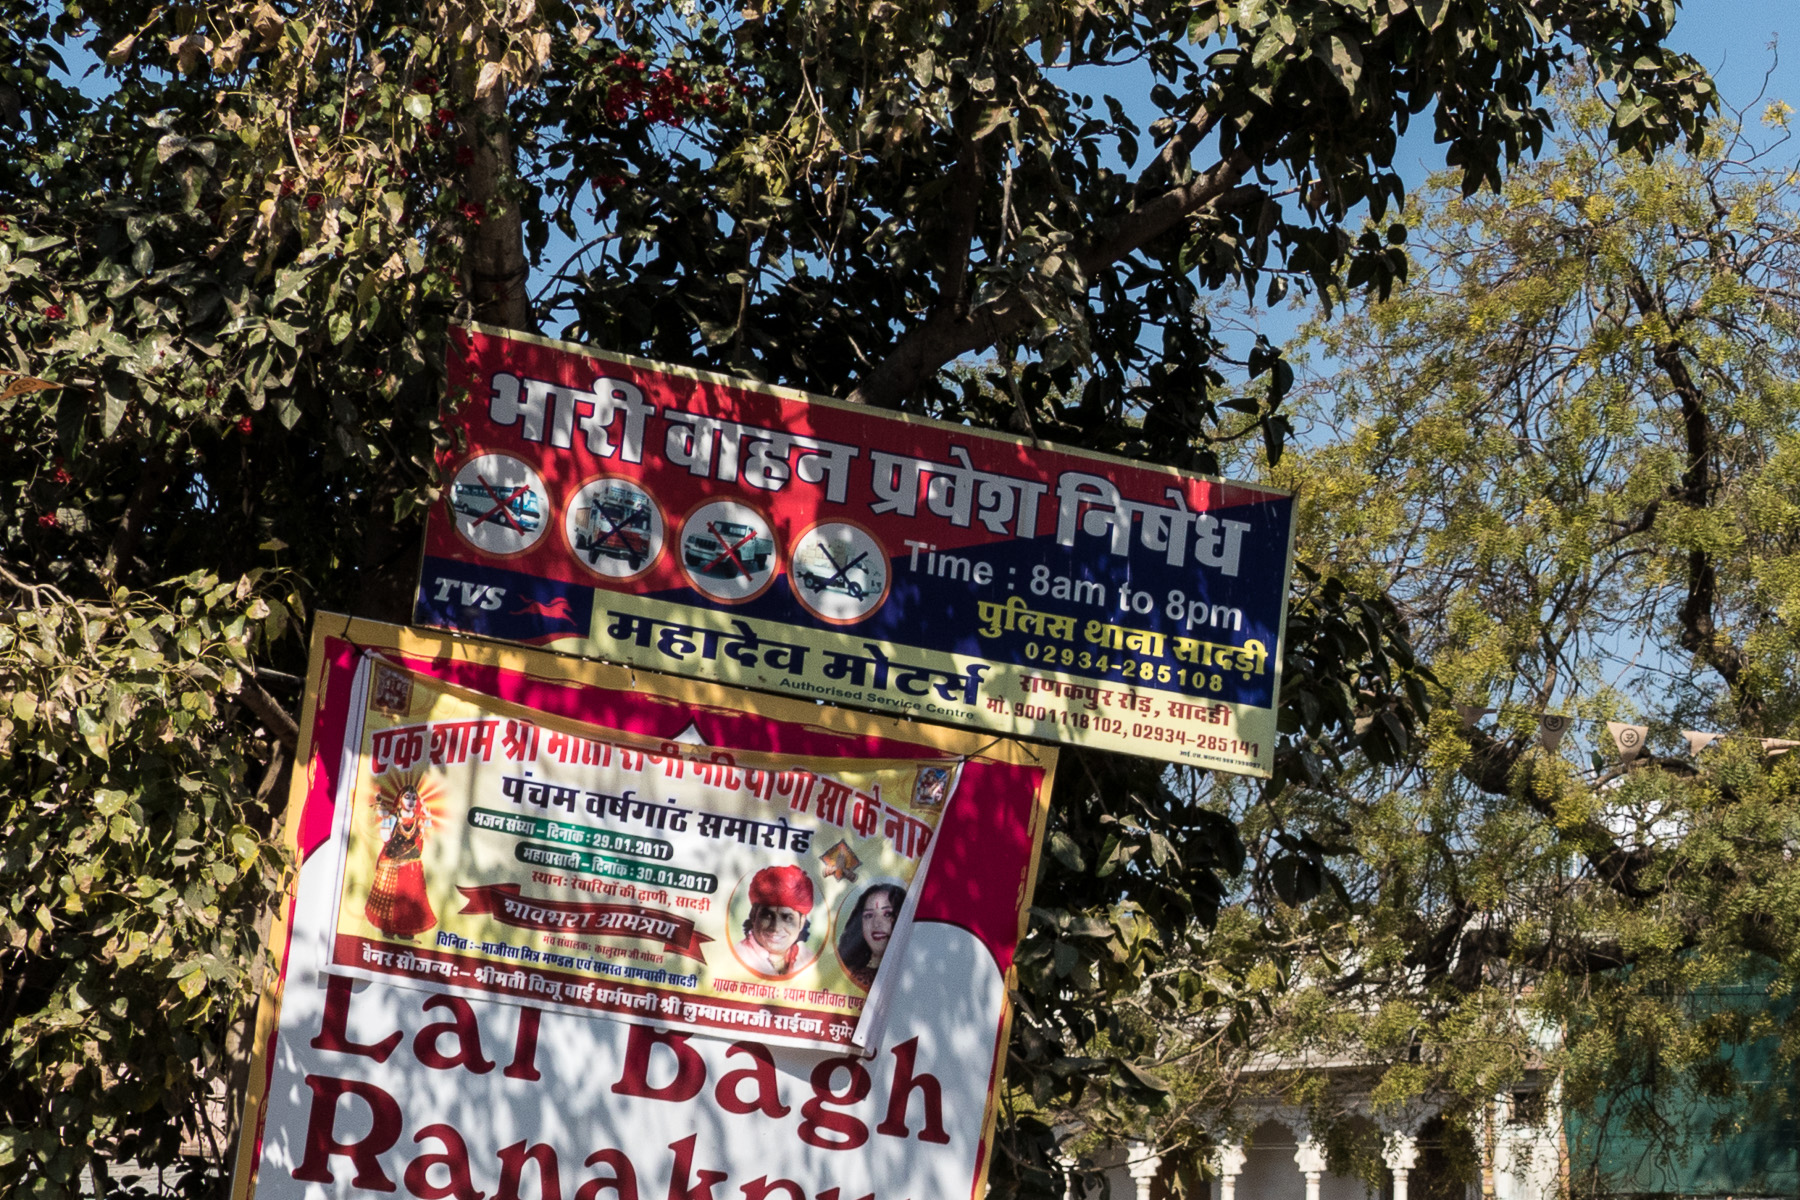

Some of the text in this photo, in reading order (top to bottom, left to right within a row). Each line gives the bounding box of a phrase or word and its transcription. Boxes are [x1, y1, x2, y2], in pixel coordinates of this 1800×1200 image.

[489, 372, 1251, 577] भारी वाहन प्रवेश निषेध
[433, 577, 507, 611] TVS
[904, 539, 1242, 632] Time 8am to 8pm
[607, 610, 991, 706] महादेव मोटर्स
[977, 596, 1268, 681] पुलिस थाना सादड़ी
[1025, 642, 1223, 692] 02934-285108
[780, 677, 975, 721] Authorised Service Centre
[1019, 674, 1114, 710] राणकपुर
[1167, 703, 1233, 727] सादडी
[986, 695, 1009, 715] मो.
[1132, 723, 1260, 758] 02934-285141
[370, 724, 427, 775] एक
[429, 719, 500, 768] शाम
[502, 717, 542, 762] श्री
[816, 777, 853, 827] सा
[852, 783, 881, 839] के
[474, 811, 504, 830] भजन
[506, 815, 536, 834] संध्या
[592, 833, 669, 858] 29.01.2017
[502, 772, 814, 853] पंचम वर्षगांठ समारोह
[523, 847, 581, 868] महाप्रसादी
[636, 866, 712, 891] 30.01.2017
[620, 880, 635, 898] की
[504, 898, 680, 939] भावभरा आमंत्रण
[362, 941, 392, 963] बैनर
[474, 965, 526, 991] श्रीमती
[565, 982, 595, 1005] बाई
[596, 983, 657, 1012] धर्मपत्नी
[660, 996, 681, 1016] श्री
[542, 951, 574, 969] मण्डल
[593, 961, 622, 977] समस्त
[624, 964, 667, 983] ग्रामवासी
[668, 972, 698, 989] सादडी
[713, 977, 738, 994] गायक
[310, 975, 951, 1151] Lal Bagh
